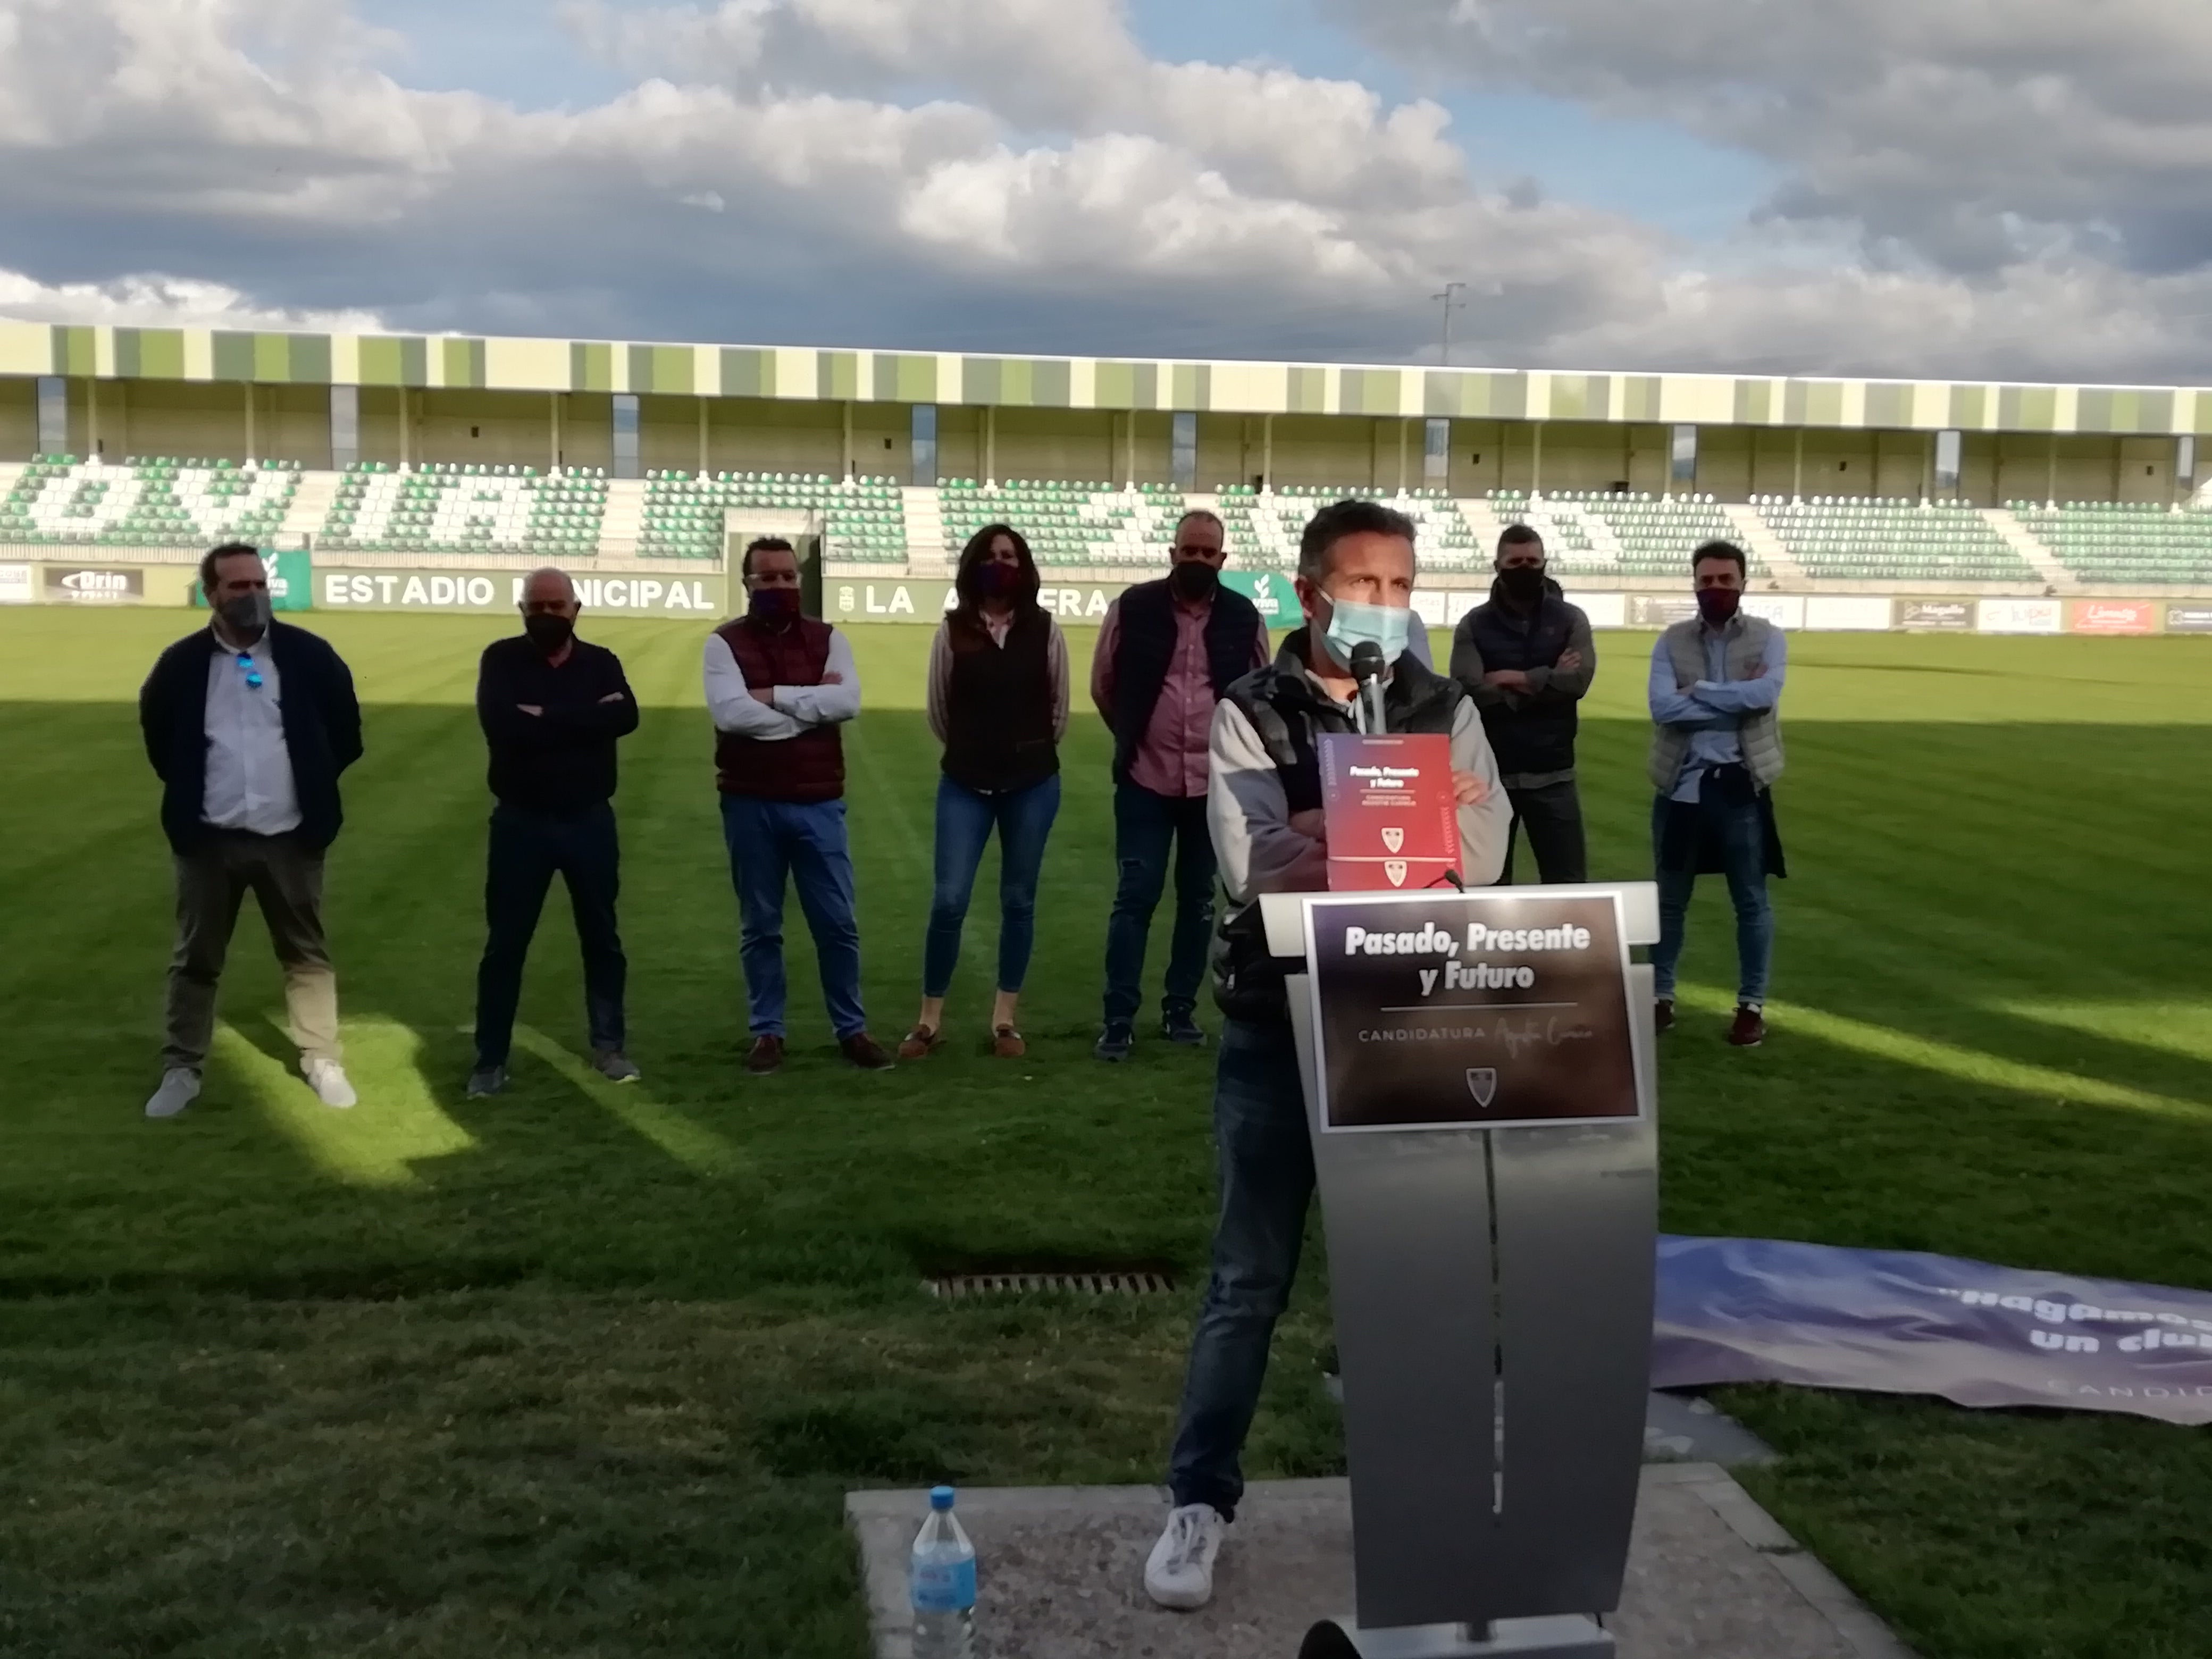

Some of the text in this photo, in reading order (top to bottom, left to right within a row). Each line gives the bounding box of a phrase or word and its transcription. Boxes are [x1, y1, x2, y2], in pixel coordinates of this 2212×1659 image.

[325, 575, 714, 609] ESTADIO NICIPAL
[866, 585, 1109, 616] LA AERA
[1345, 921, 1590, 957] Pasado, Presente
[1419, 960, 1535, 996] y Futuro
[1358, 1027, 1486, 1043] CANDIDATURA
[2030, 1329, 2099, 1353] un
